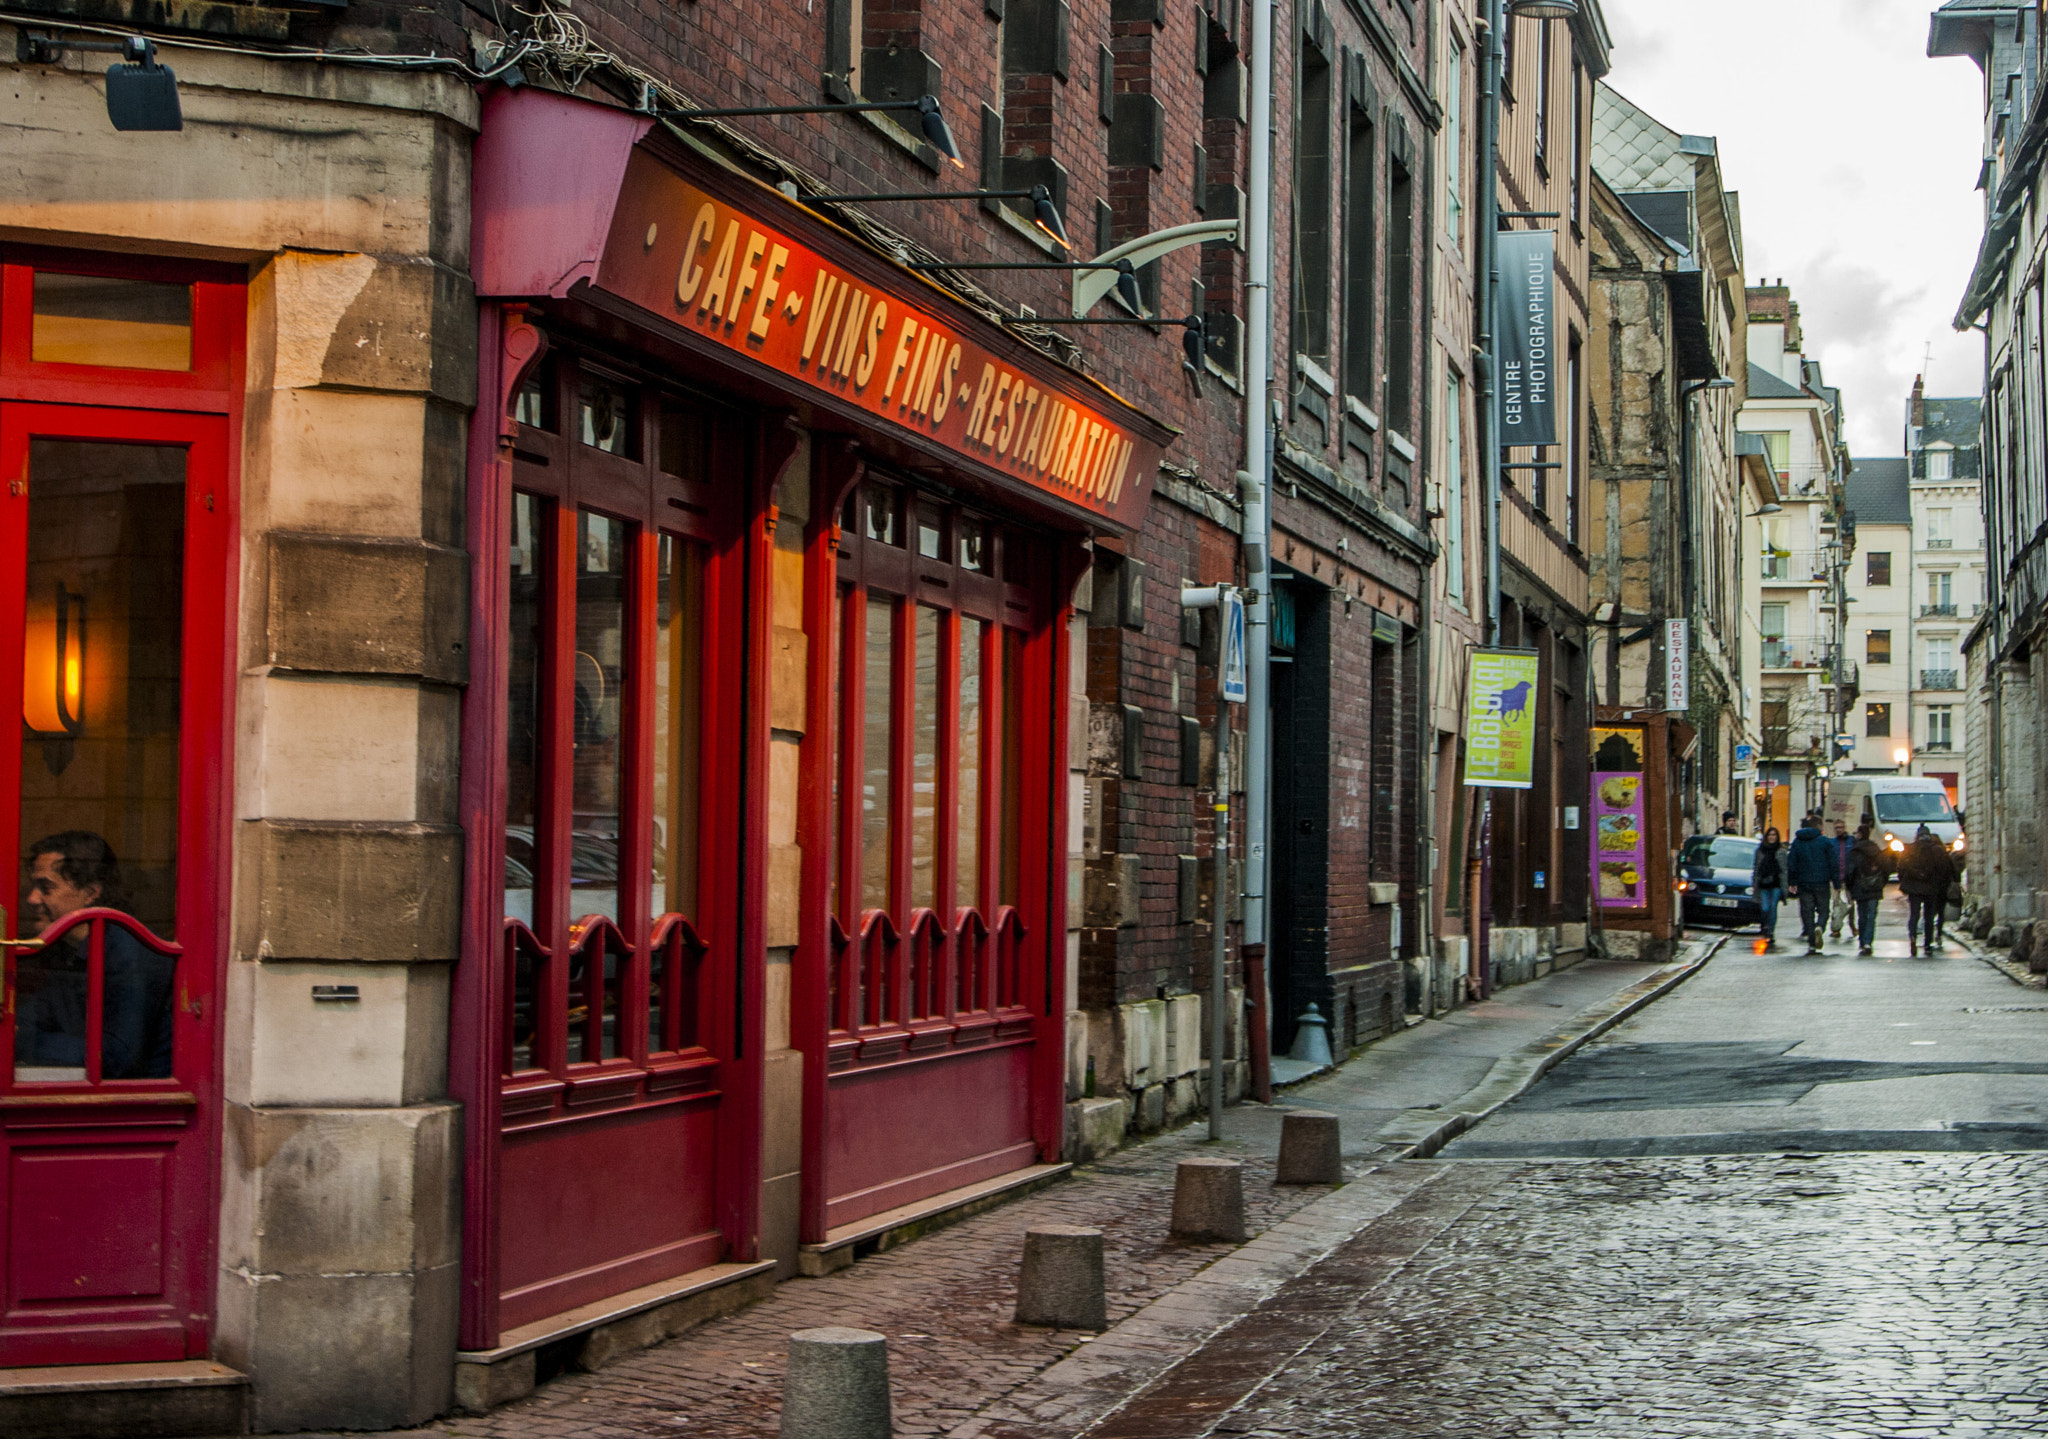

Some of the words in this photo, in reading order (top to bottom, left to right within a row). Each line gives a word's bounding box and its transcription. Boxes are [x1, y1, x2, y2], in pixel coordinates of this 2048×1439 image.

[677, 202, 789, 340] CAFE
[801, 269, 888, 388] VINS
[885, 317, 961, 423] FINS
[965, 364, 1134, 506] RESTAURATION
[1529, 252, 1546, 404] PHOTOGRAPHIQUE
[1505, 360, 1521, 425] CENTRE
[1671, 622, 1683, 706] RESTAURANT
[1470, 755, 1499, 777] LE
